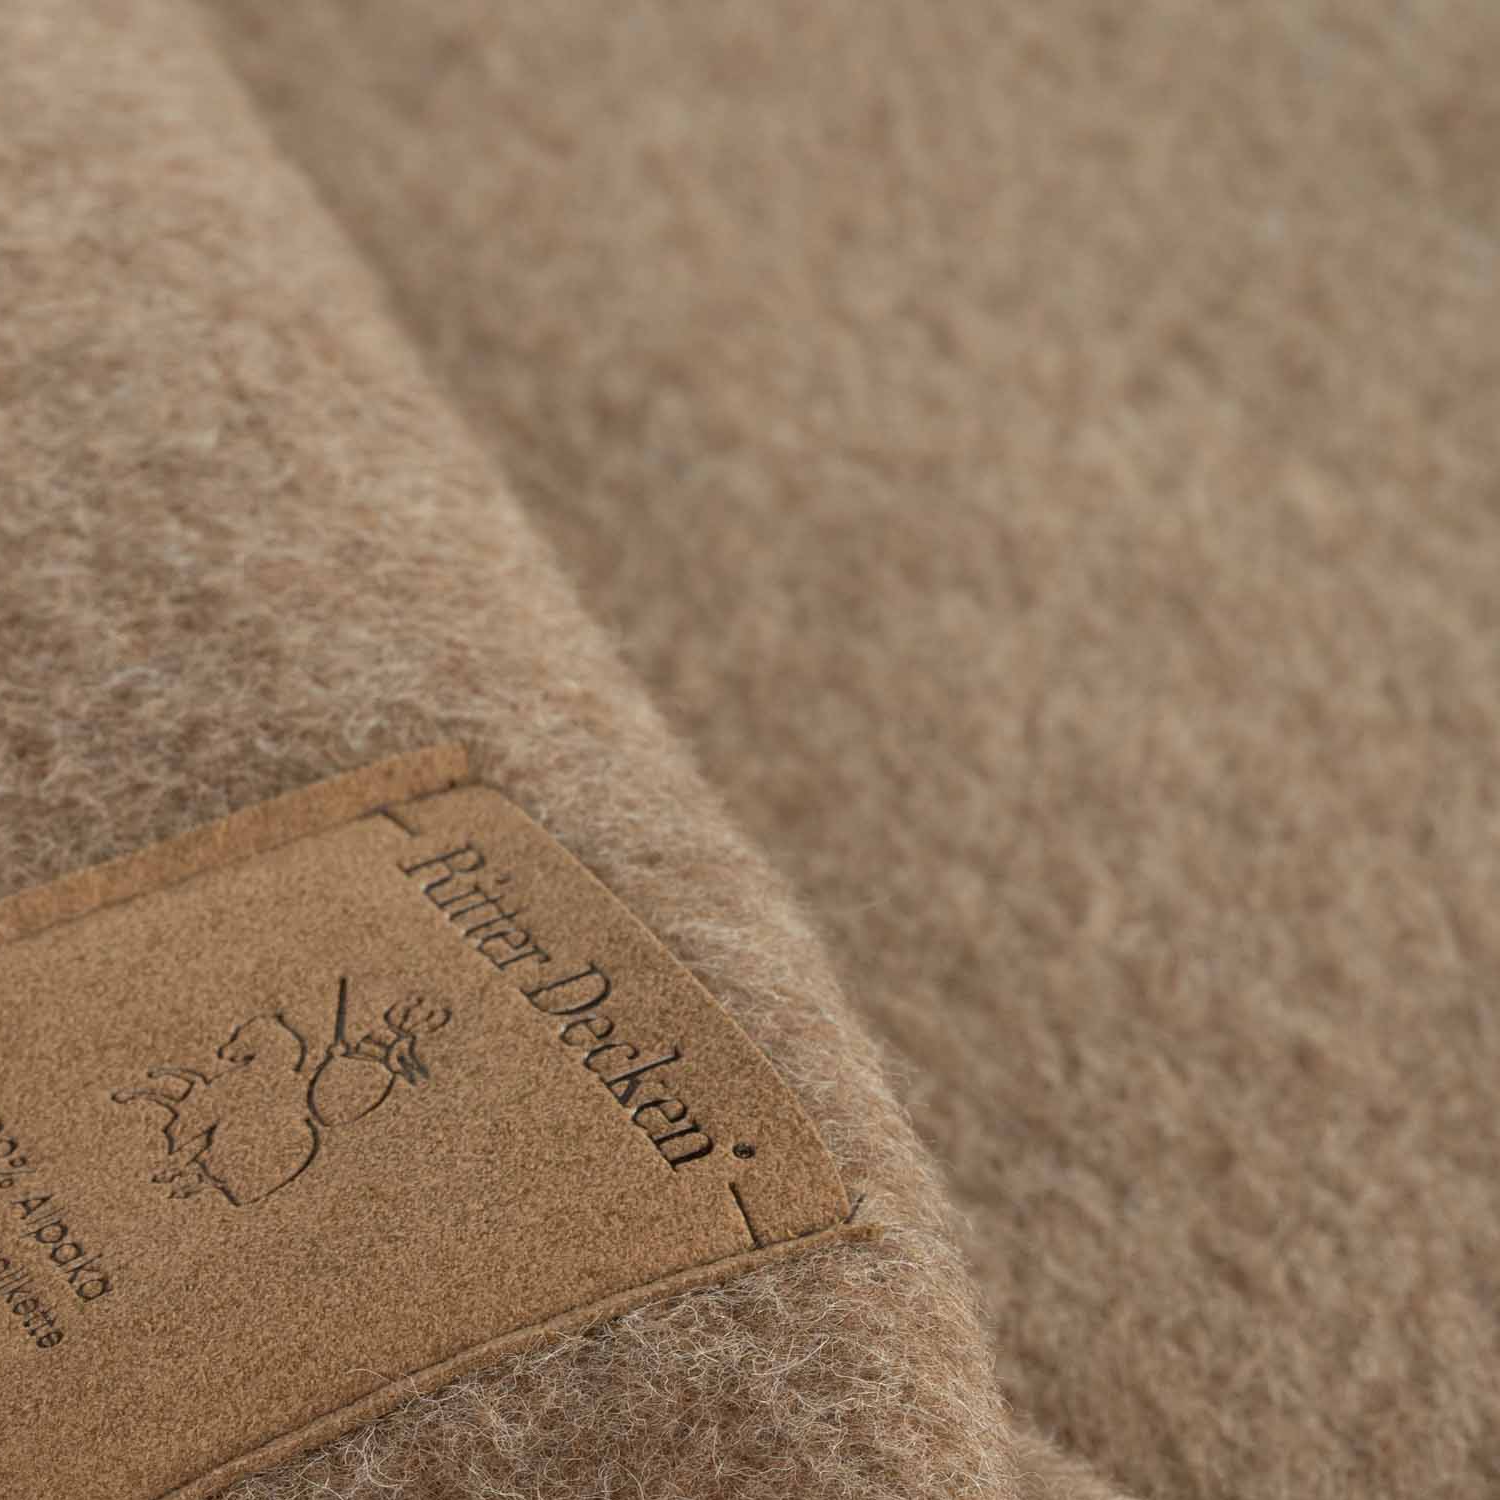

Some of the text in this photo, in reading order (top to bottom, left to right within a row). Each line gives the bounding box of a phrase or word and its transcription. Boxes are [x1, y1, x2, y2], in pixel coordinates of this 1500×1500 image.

[397, 841, 715, 1172] Ritter Decken
[10, 1194, 113, 1301] Alpaka
